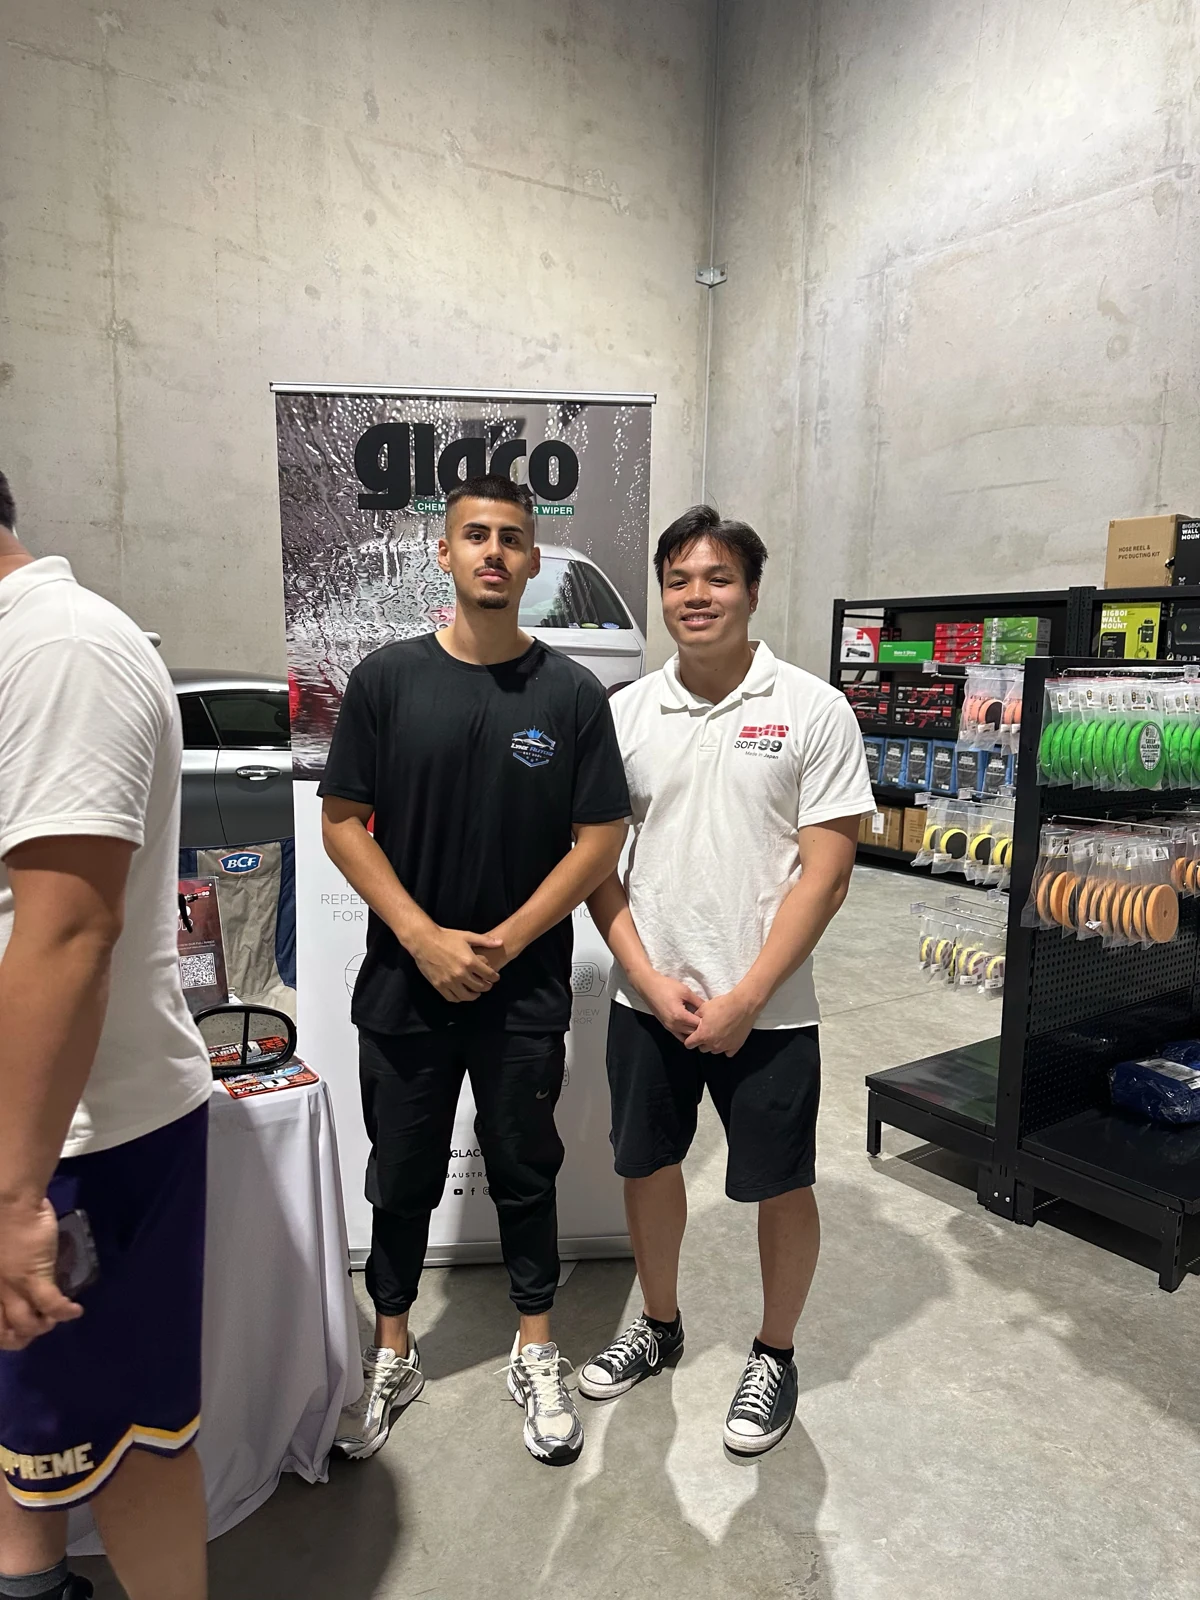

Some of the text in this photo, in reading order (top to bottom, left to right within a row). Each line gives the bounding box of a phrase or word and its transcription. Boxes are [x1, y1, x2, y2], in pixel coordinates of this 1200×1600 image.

[541, 506, 573, 515] WIPER
[226, 857, 258, 869] BCF
[332, 911, 364, 922] FOR
[576, 1008, 600, 1016] VIEW
[571, 1017, 593, 1025] ROR
[0, 1442, 96, 1480] PREME
